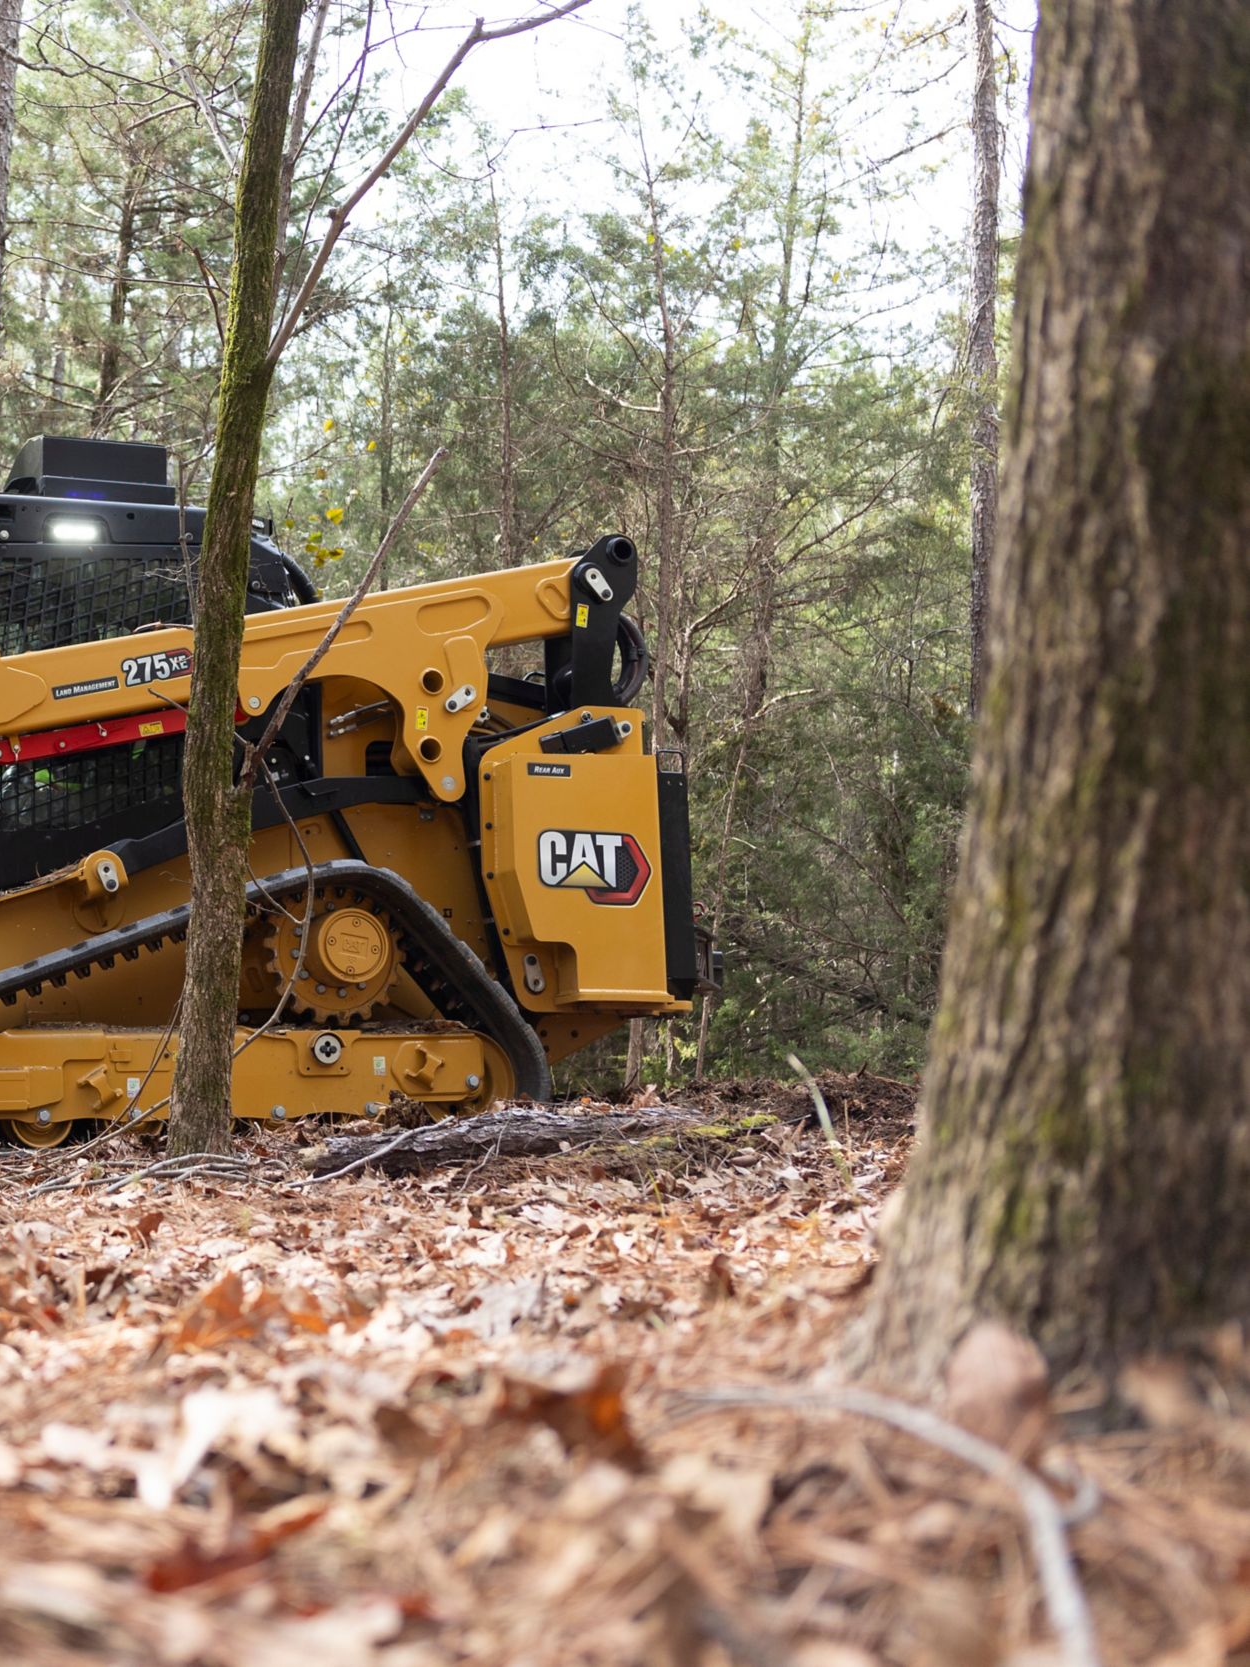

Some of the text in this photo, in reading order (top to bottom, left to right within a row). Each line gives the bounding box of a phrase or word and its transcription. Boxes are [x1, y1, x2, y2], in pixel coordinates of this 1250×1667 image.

[55, 680, 116, 697] LAND MANAGEMENT
[539, 831, 623, 888] CAT
